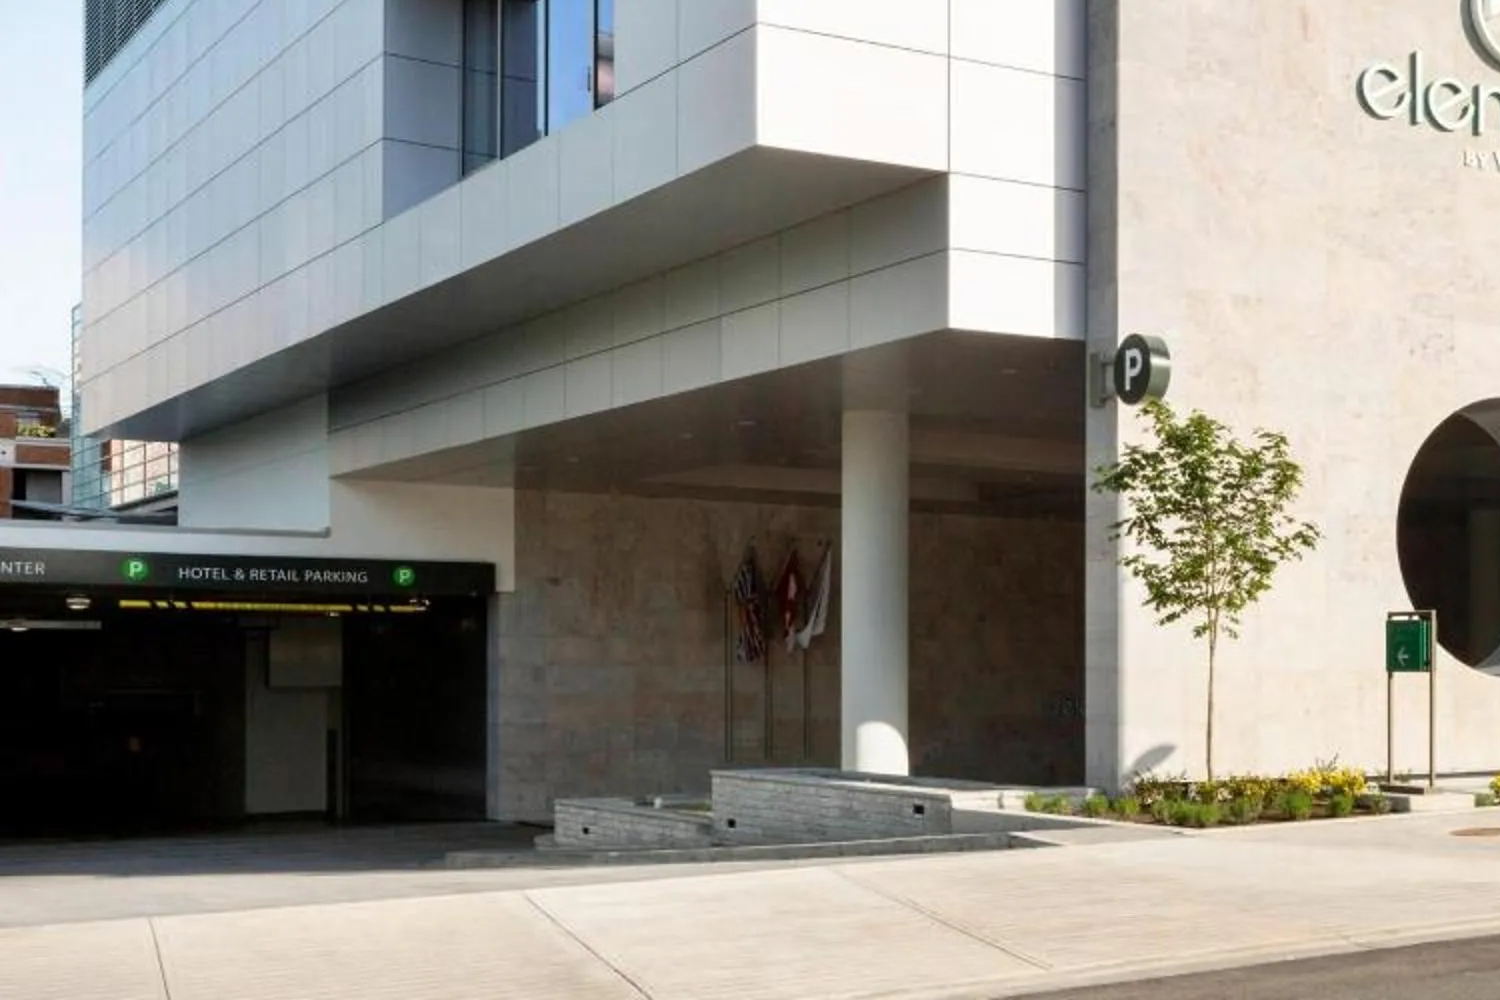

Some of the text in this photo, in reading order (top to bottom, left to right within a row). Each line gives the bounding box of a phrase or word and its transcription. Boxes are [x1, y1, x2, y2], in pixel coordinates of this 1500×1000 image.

[1463, 150, 1487, 169] BY
[1125, 347, 1143, 391] P
[128, 560, 144, 578] P
[178, 567, 369, 584] HOTEL & RETAIL PARKING
[399, 569, 411, 583] P
